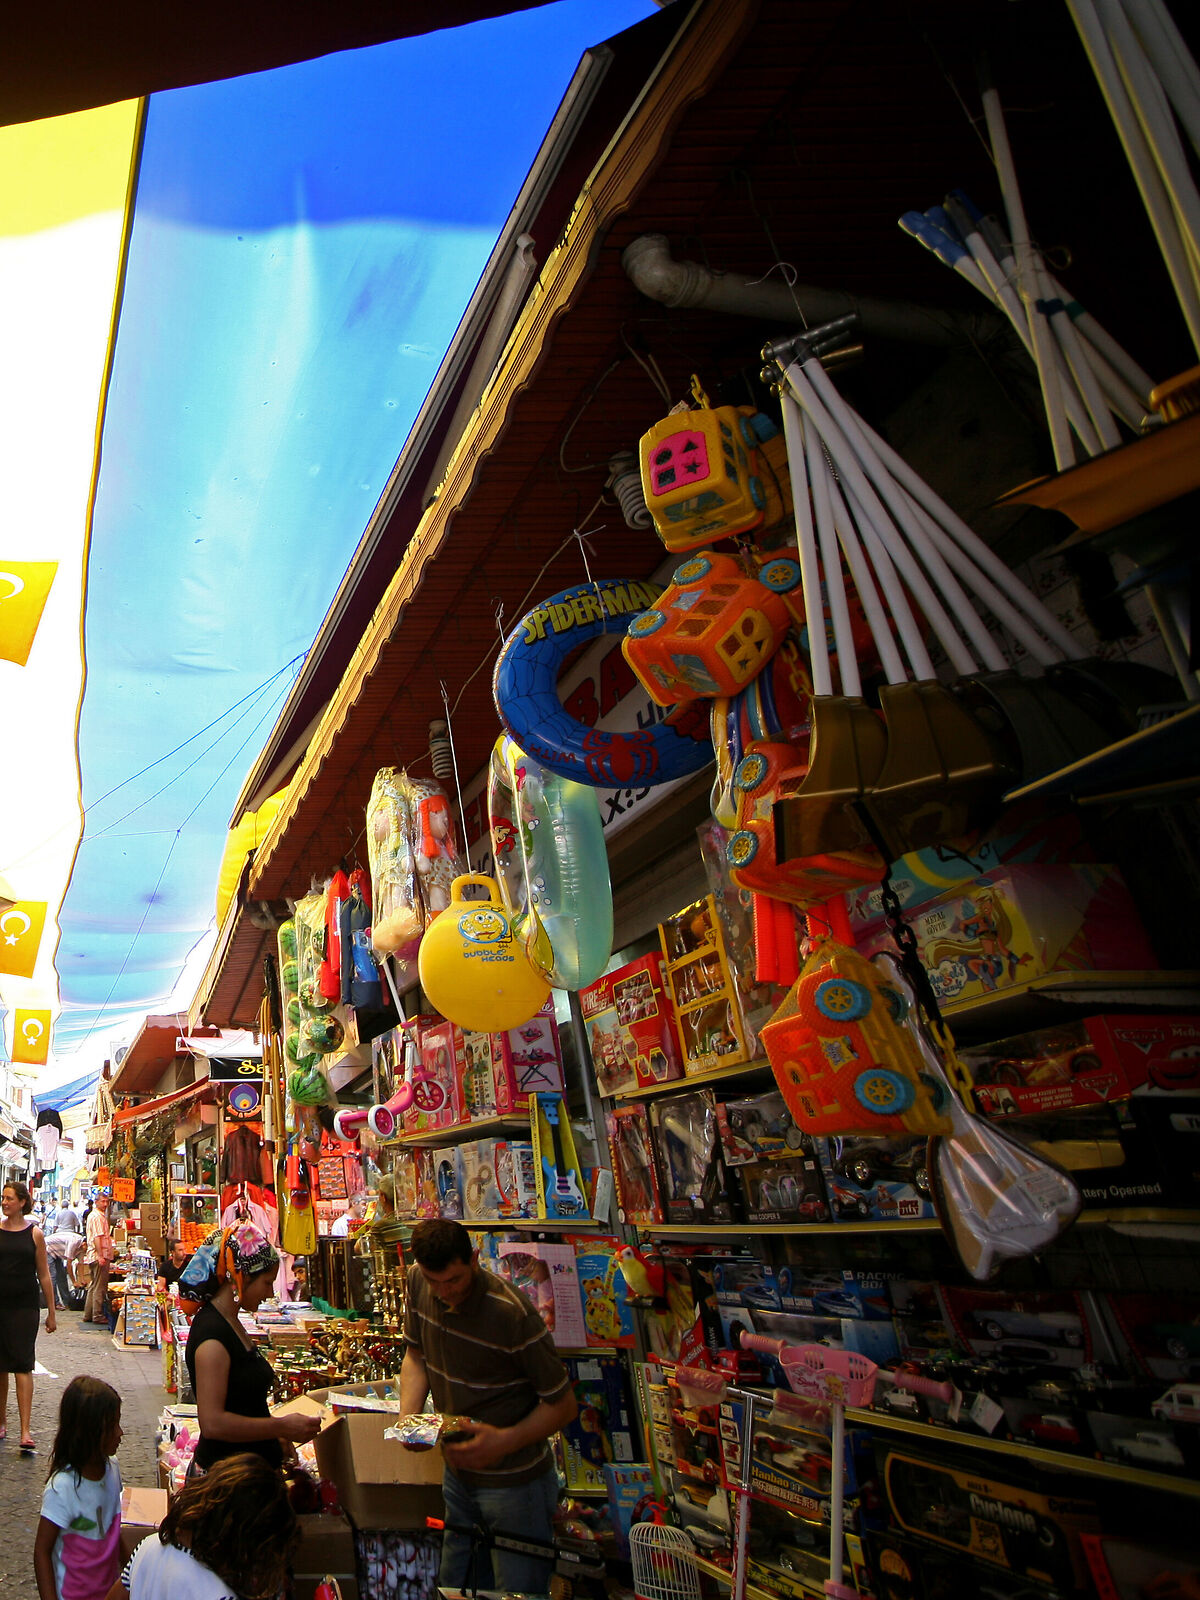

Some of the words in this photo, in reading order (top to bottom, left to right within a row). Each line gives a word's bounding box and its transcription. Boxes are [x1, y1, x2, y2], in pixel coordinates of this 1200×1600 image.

[1081, 1187, 1108, 1200] ttery
[1109, 1182, 1163, 1199] Operated
[856, 1271, 905, 1281] RACING
[752, 1465, 790, 1488] Hanbao
